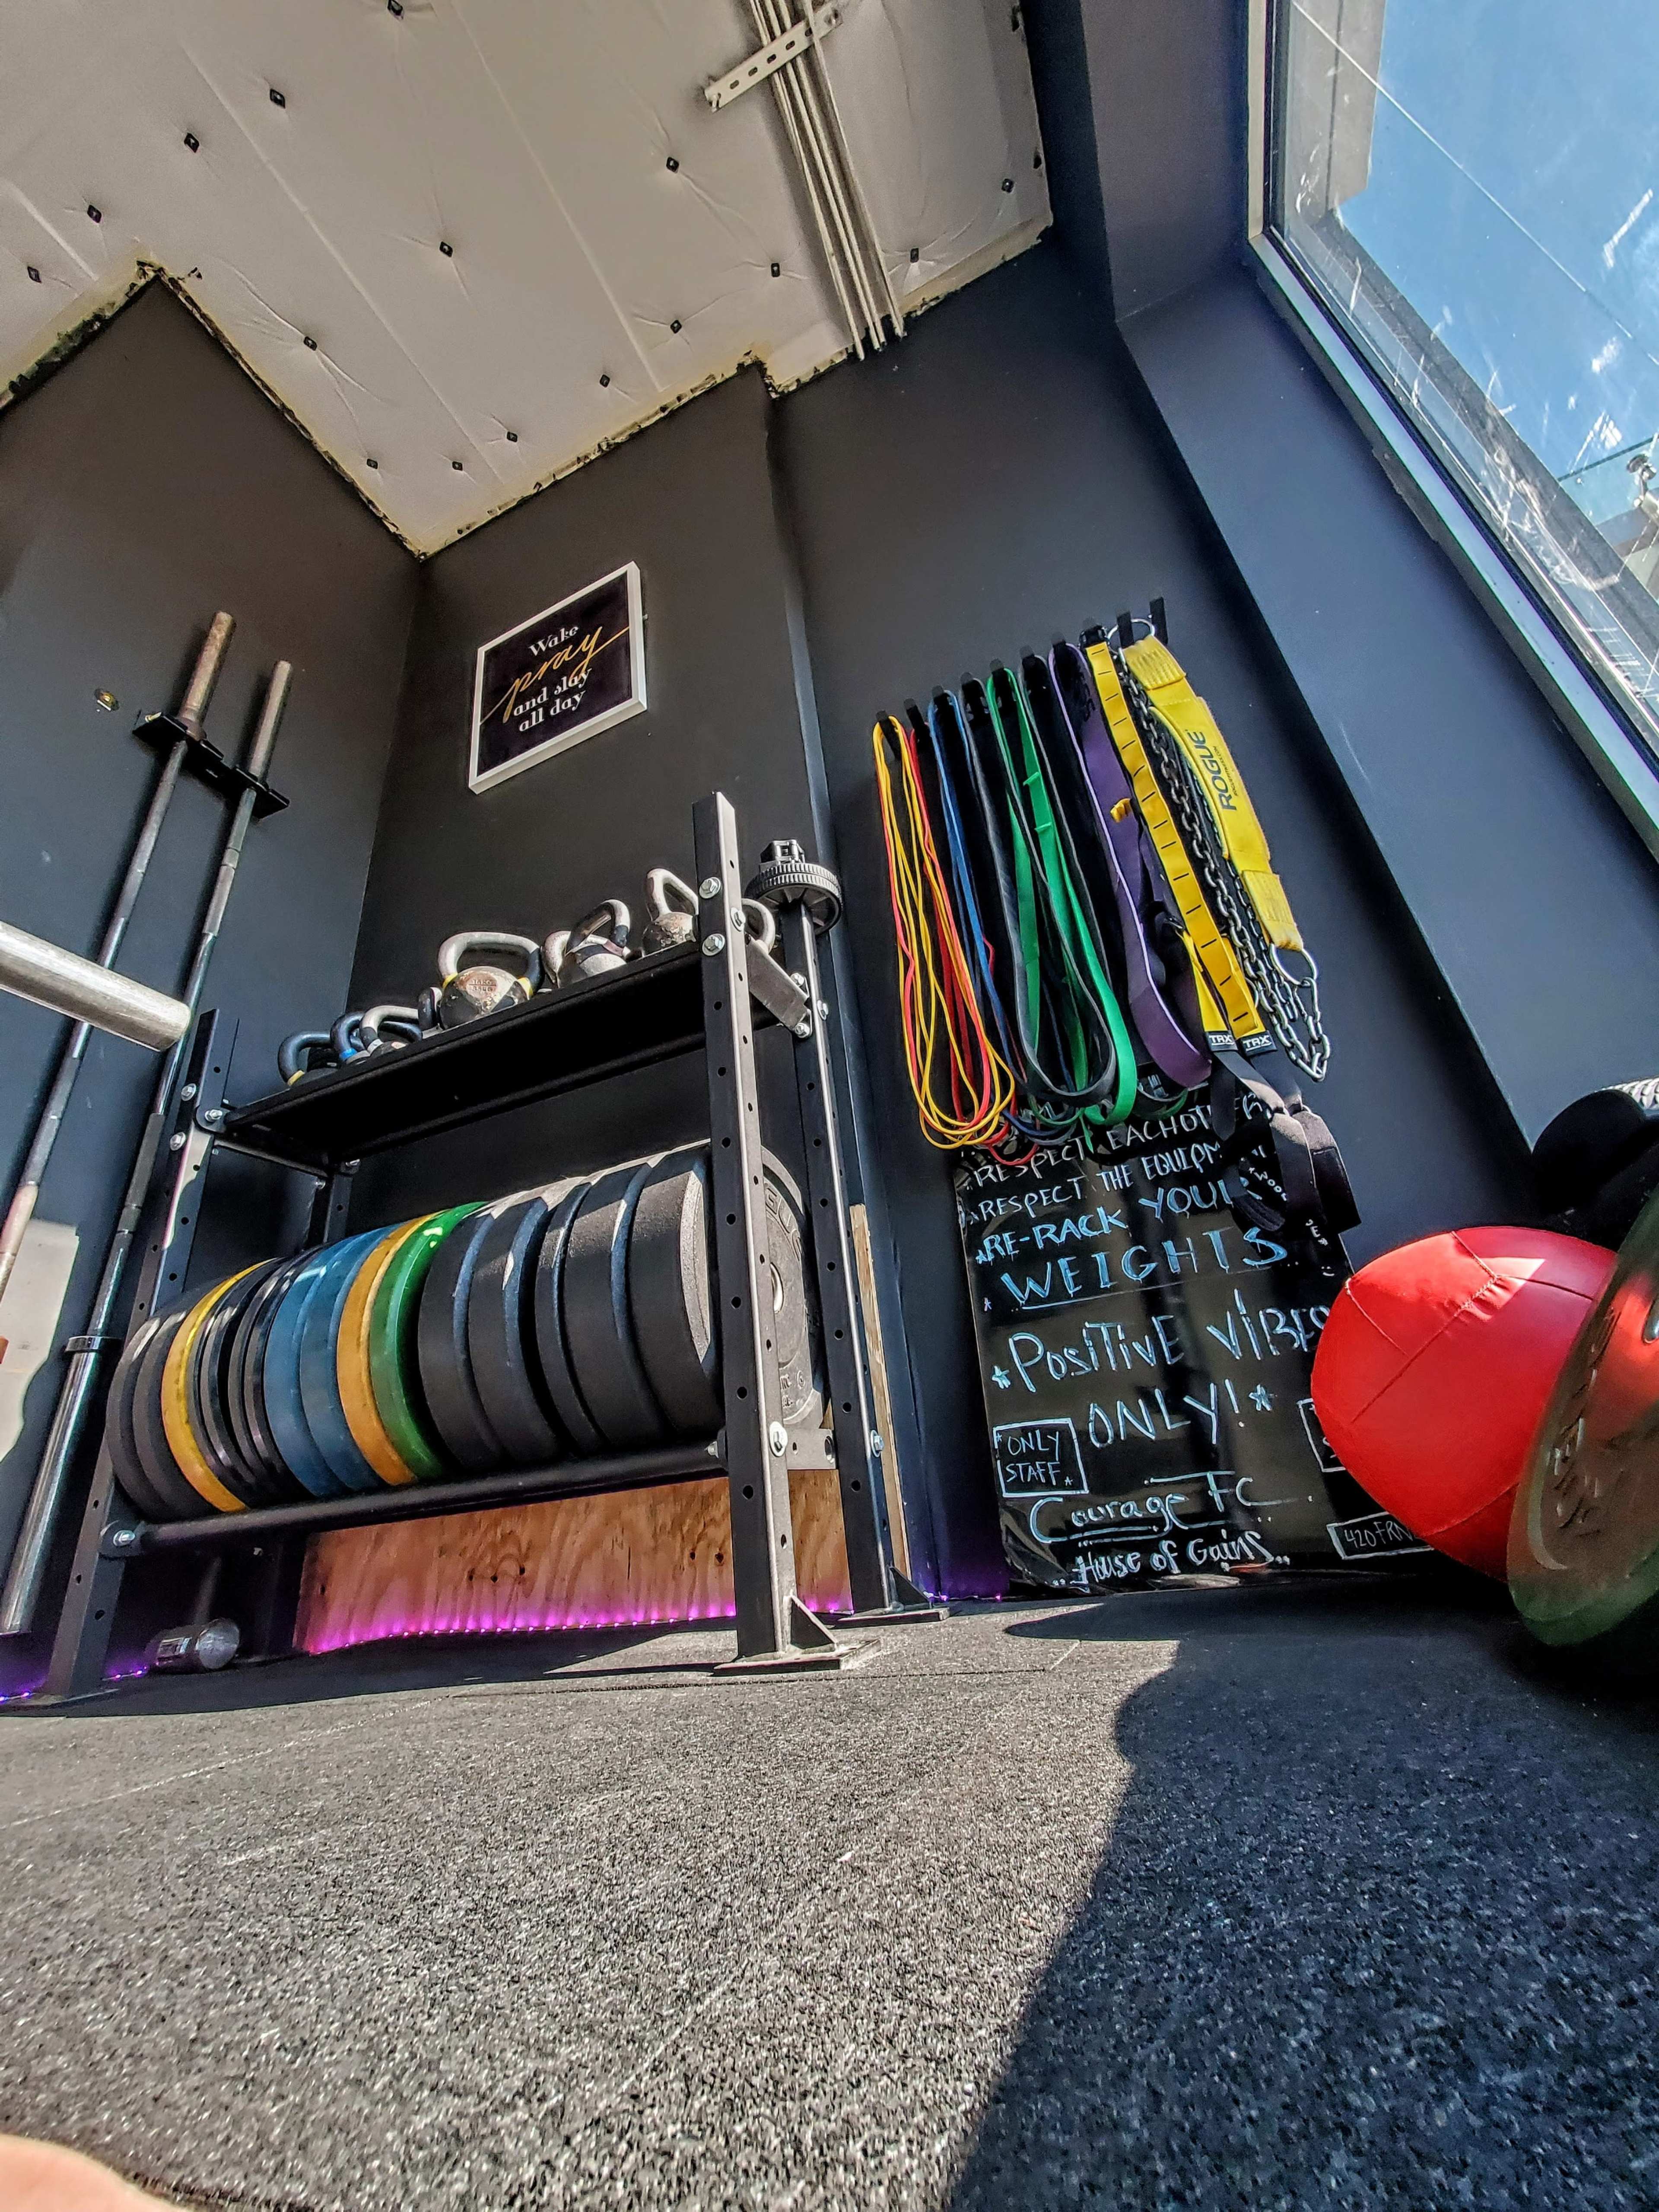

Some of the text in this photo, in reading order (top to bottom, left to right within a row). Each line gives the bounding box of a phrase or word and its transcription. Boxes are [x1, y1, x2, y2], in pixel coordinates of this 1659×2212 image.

[528, 625, 579, 657] Wake
[481, 626, 629, 724] pray
[513, 668, 592, 717] and slay
[519, 690, 586, 732] all day
[1187, 731, 1237, 811] ROGUE
[1208, 1035, 1233, 1044] TRX
[1243, 1035, 1270, 1048] TRX
[974, 1135, 1086, 1188] RESPECT
[978, 1175, 1087, 1221] RESPECT
[1096, 1164, 1134, 1192] THE
[983, 1206, 1128, 1262] RE-RACK
[1001, 1226, 1287, 1304] WEIGHTS
[1007, 1429, 1059, 1462] ONLY
[1005, 1462, 1061, 1485] STAFF
[1029, 1493, 1193, 1543] Courage
[1070, 1551, 1141, 1586] House
[1150, 1540, 1181, 1574] of
